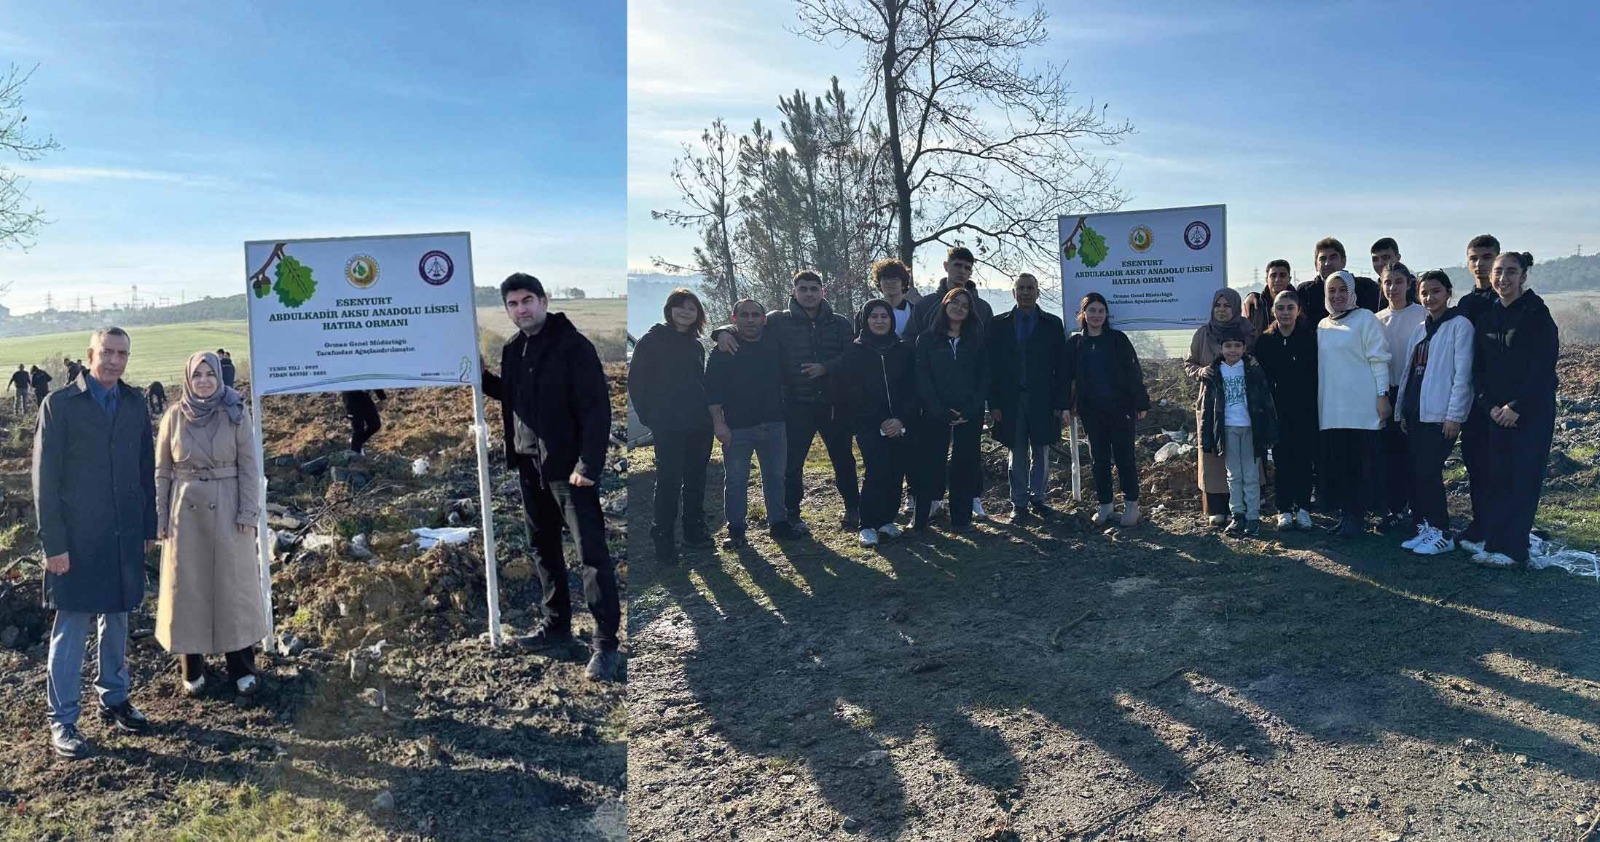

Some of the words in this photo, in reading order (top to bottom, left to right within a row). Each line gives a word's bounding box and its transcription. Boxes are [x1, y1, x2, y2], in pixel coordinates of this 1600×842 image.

[1121, 259, 1164, 267] ESENYURT
[1126, 268, 1146, 276] AKSU
[1148, 267, 1184, 275] ANADOLU
[1187, 263, 1213, 273] LİSESİ
[1143, 276, 1175, 284] ORMANI
[336, 297, 392, 307] ESENYURT
[269, 308, 338, 322] ABDULKADİR
[341, 308, 369, 318] AKSU
[374, 307, 421, 317] ANADOLU
[424, 303, 459, 314] LİSESİ
[323, 321, 362, 331] HATIRA
[366, 319, 408, 328] ORMANI
